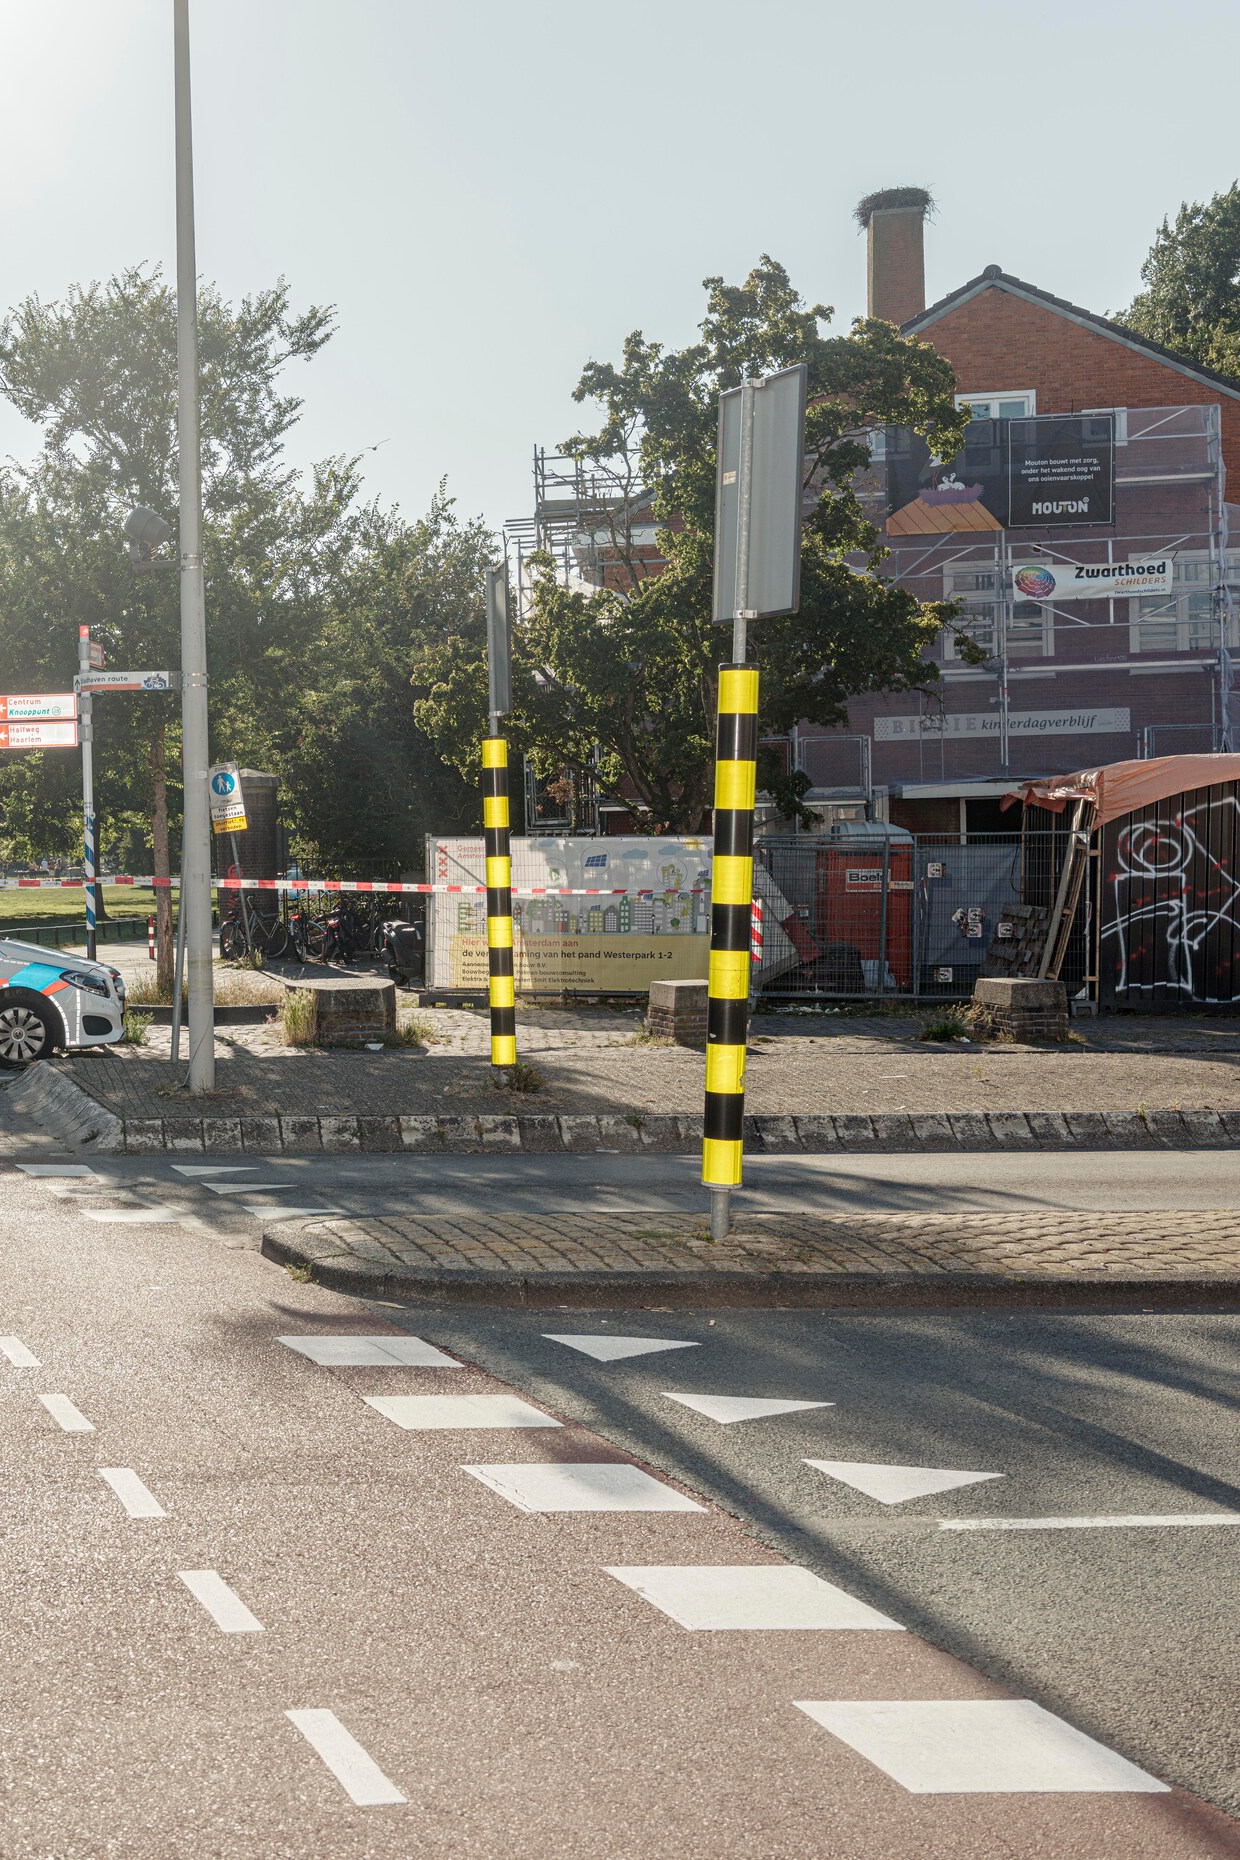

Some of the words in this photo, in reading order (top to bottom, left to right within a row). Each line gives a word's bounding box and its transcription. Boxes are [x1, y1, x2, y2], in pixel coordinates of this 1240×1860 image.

[1032, 501, 1088, 515] MOUTON
[1075, 561, 1166, 579] Zwarthoed
[1114, 576, 1167, 586] SCHILDERS
[1114, 587, 1166, 595] zwarthoedschilders.nl
[9, 708, 50, 716] Knooppunt
[10, 726, 40, 734] Halfweg
[214, 811, 244, 819] toegestaan
[462, 938, 480, 946] Hier
[462, 949, 473, 957] de
[561, 951, 575, 959] het
[578, 951, 601, 960] pand
[603, 951, 656, 960] Westerpark
